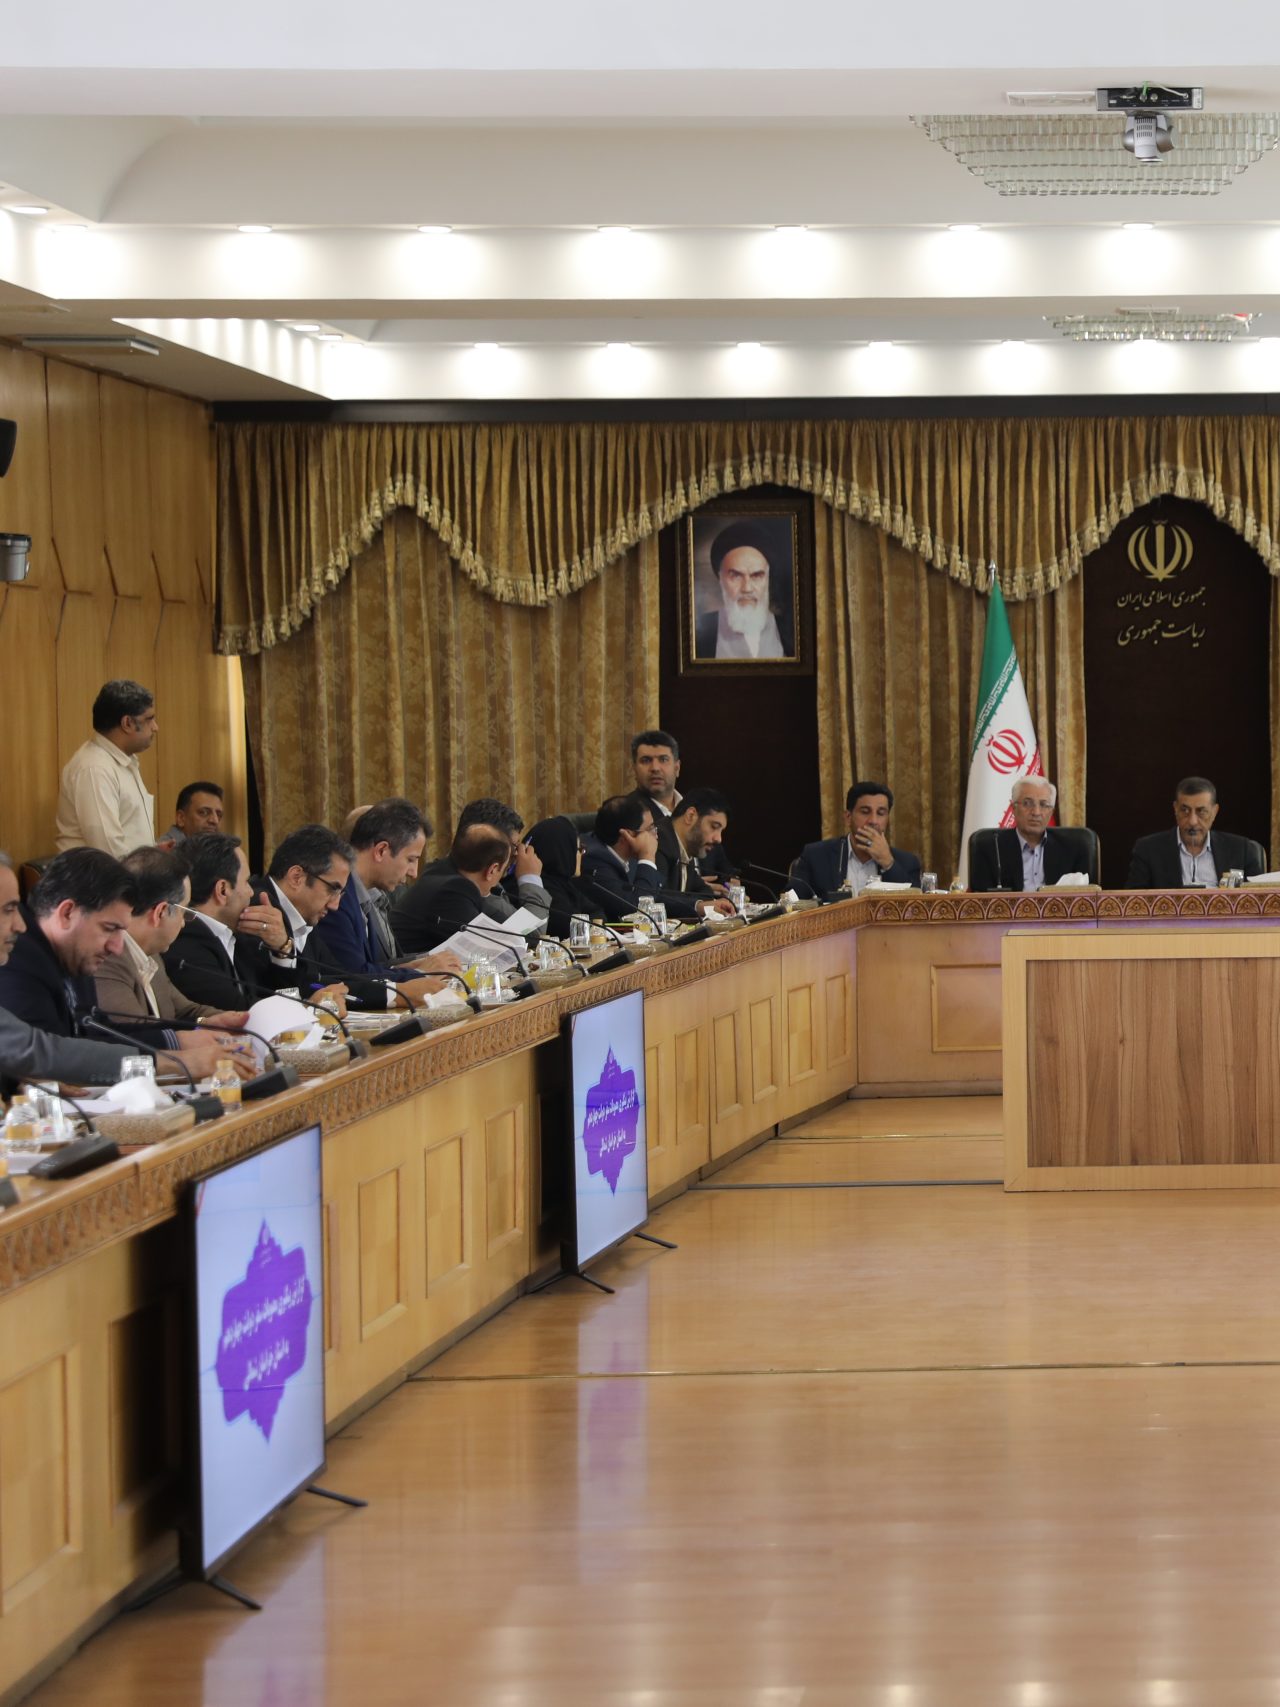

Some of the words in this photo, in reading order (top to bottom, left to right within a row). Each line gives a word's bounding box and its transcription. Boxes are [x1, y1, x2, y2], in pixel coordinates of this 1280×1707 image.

[1116, 592, 1142, 611] ایران
[1142, 590, 1172, 608] اسلامی
[1172, 586, 1206, 608] جمهوری
[1117, 619, 1162, 646] جمهوری
[1161, 622, 1206, 648] ریاست
